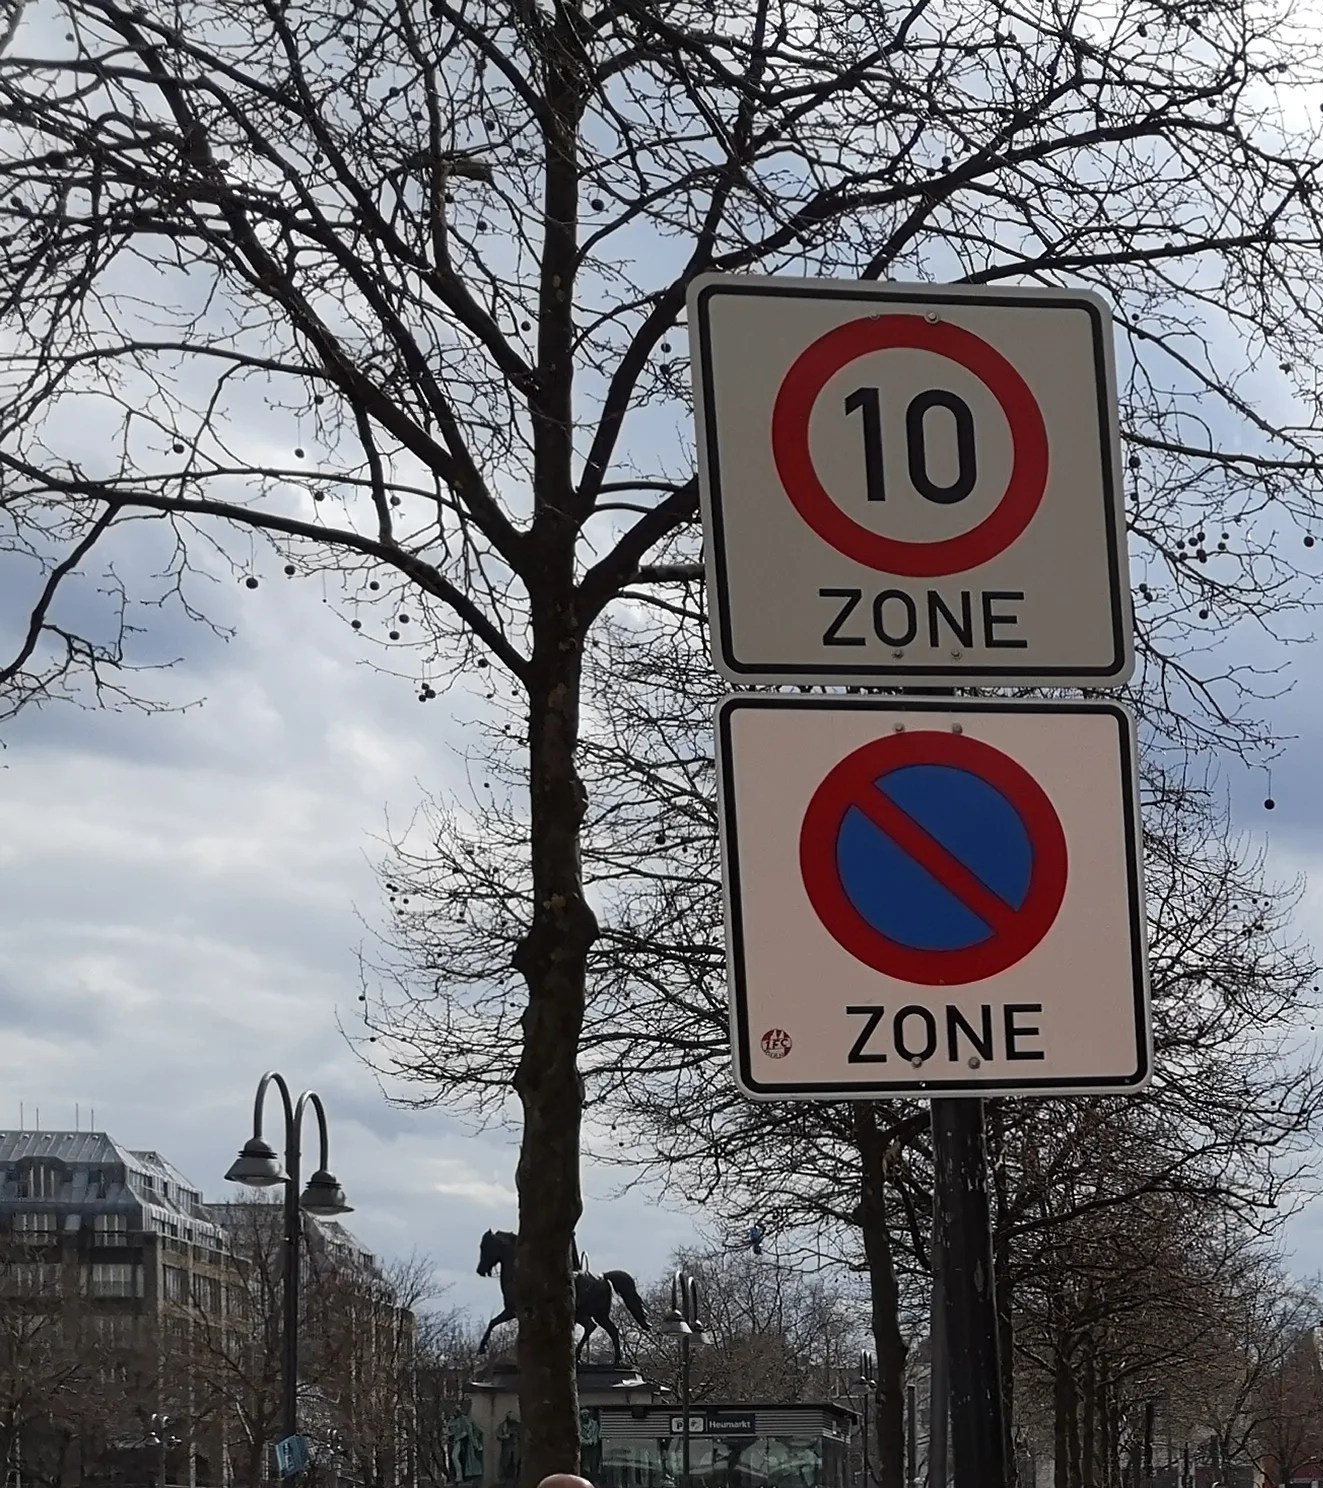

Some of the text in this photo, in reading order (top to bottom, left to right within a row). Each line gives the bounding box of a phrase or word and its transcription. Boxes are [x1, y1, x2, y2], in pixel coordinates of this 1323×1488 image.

[844, 387, 975, 505] 10
[819, 587, 1029, 649] ZONE
[846, 1002, 1045, 1064] ZONE
[709, 1420, 751, 1430] Heumarkt
